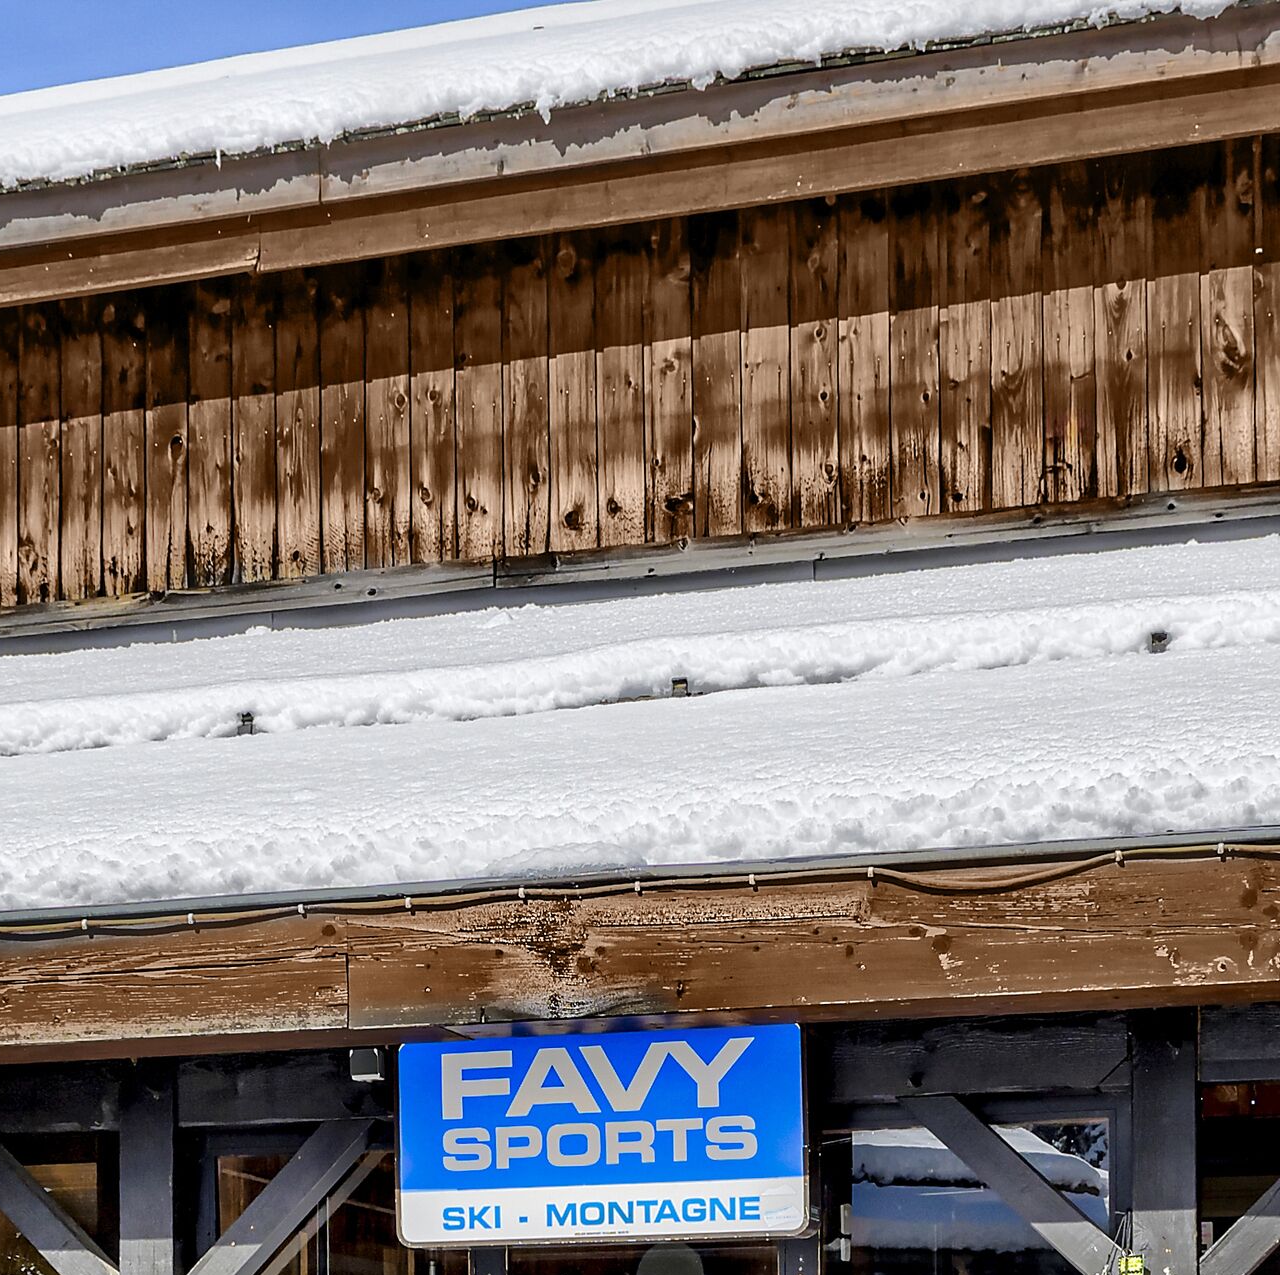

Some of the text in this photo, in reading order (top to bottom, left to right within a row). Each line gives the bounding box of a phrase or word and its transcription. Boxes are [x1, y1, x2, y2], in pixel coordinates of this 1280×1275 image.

[441, 1036, 756, 1120] FAVY
[442, 1115, 758, 1171] SPORTS
[442, 1205, 501, 1231] SKI
[546, 1196, 761, 1228] MONTAGNE
